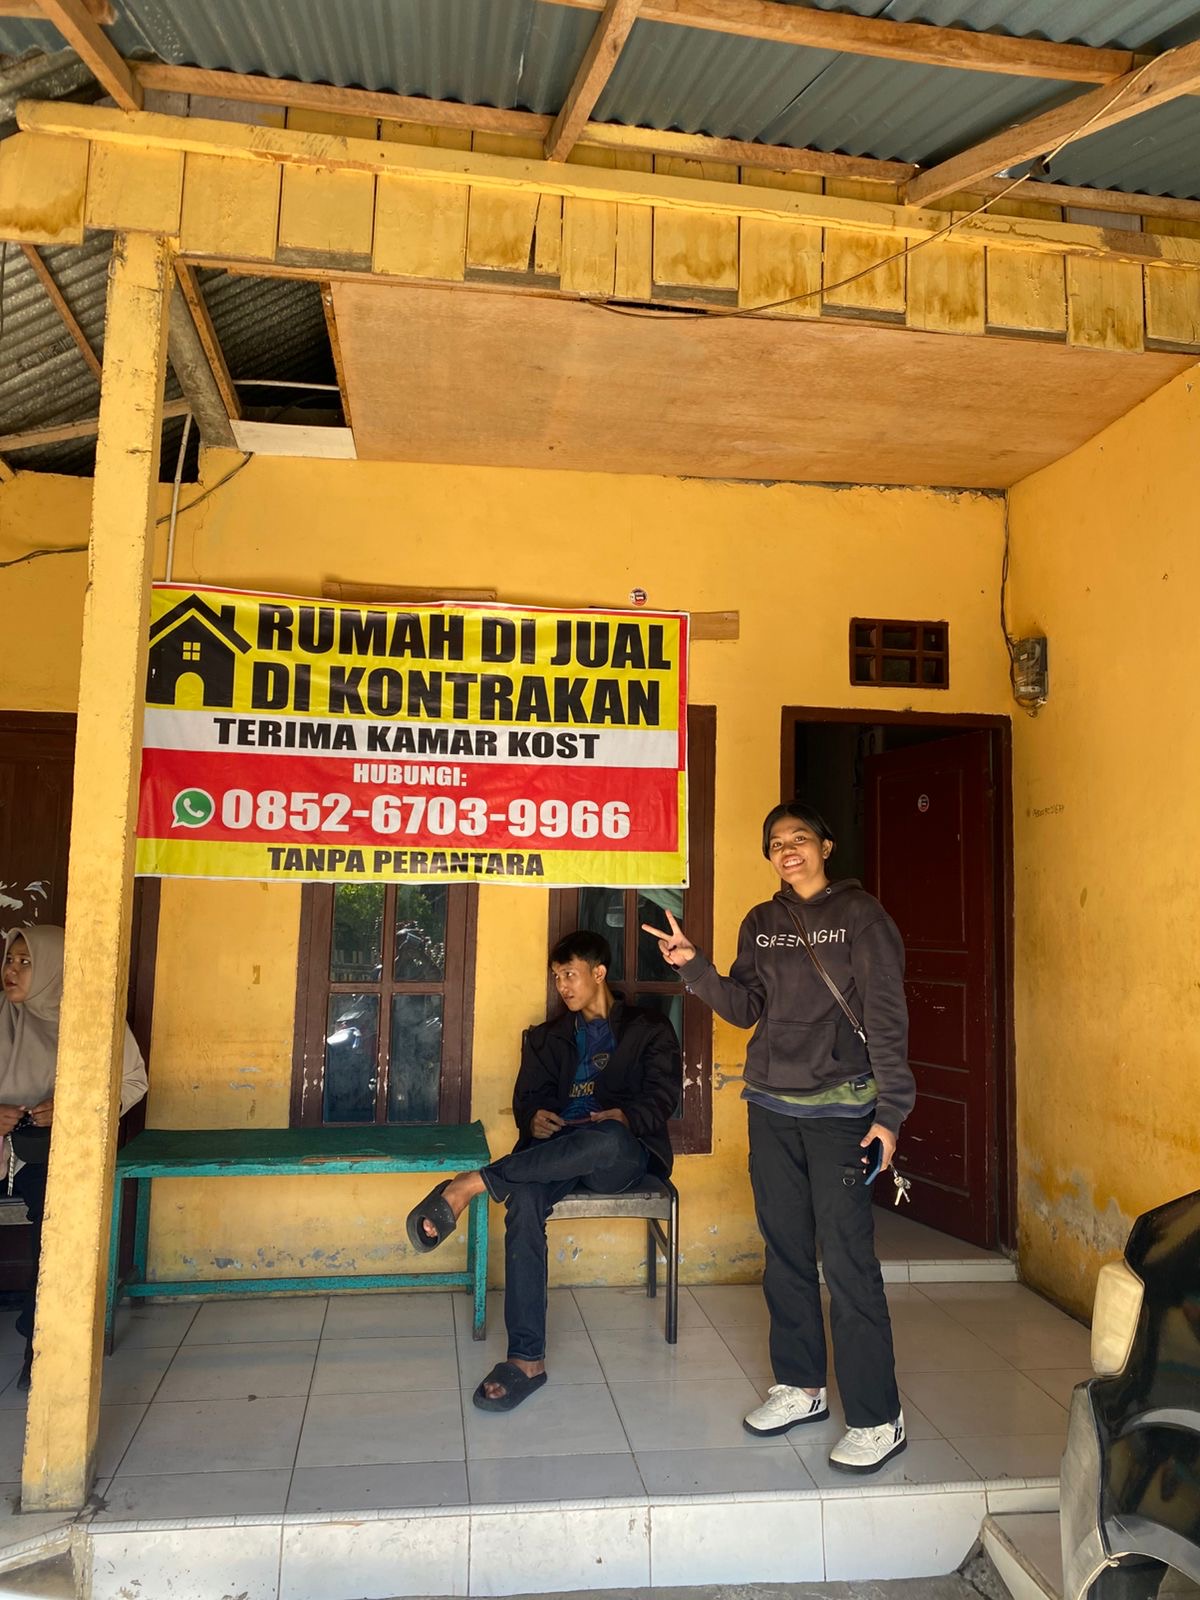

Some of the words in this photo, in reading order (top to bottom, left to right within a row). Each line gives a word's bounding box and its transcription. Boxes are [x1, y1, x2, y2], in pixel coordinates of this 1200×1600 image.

[257, 603, 464, 662] RUMAH
[481, 616, 536, 664] DI
[551, 620, 671, 670] JUAL
[251, 661, 311, 712] DI
[329, 665, 660, 726] KONTRAKAN
[213, 717, 357, 751] TERIMA
[367, 725, 498, 757] KAMAR
[508, 731, 600, 759] KOST
[353, 763, 467, 787] HUBUNGI:
[221, 788, 631, 839] 0852-6703-9966
[267, 847, 365, 873] TANPA
[373, 850, 544, 876] PERANTARA
